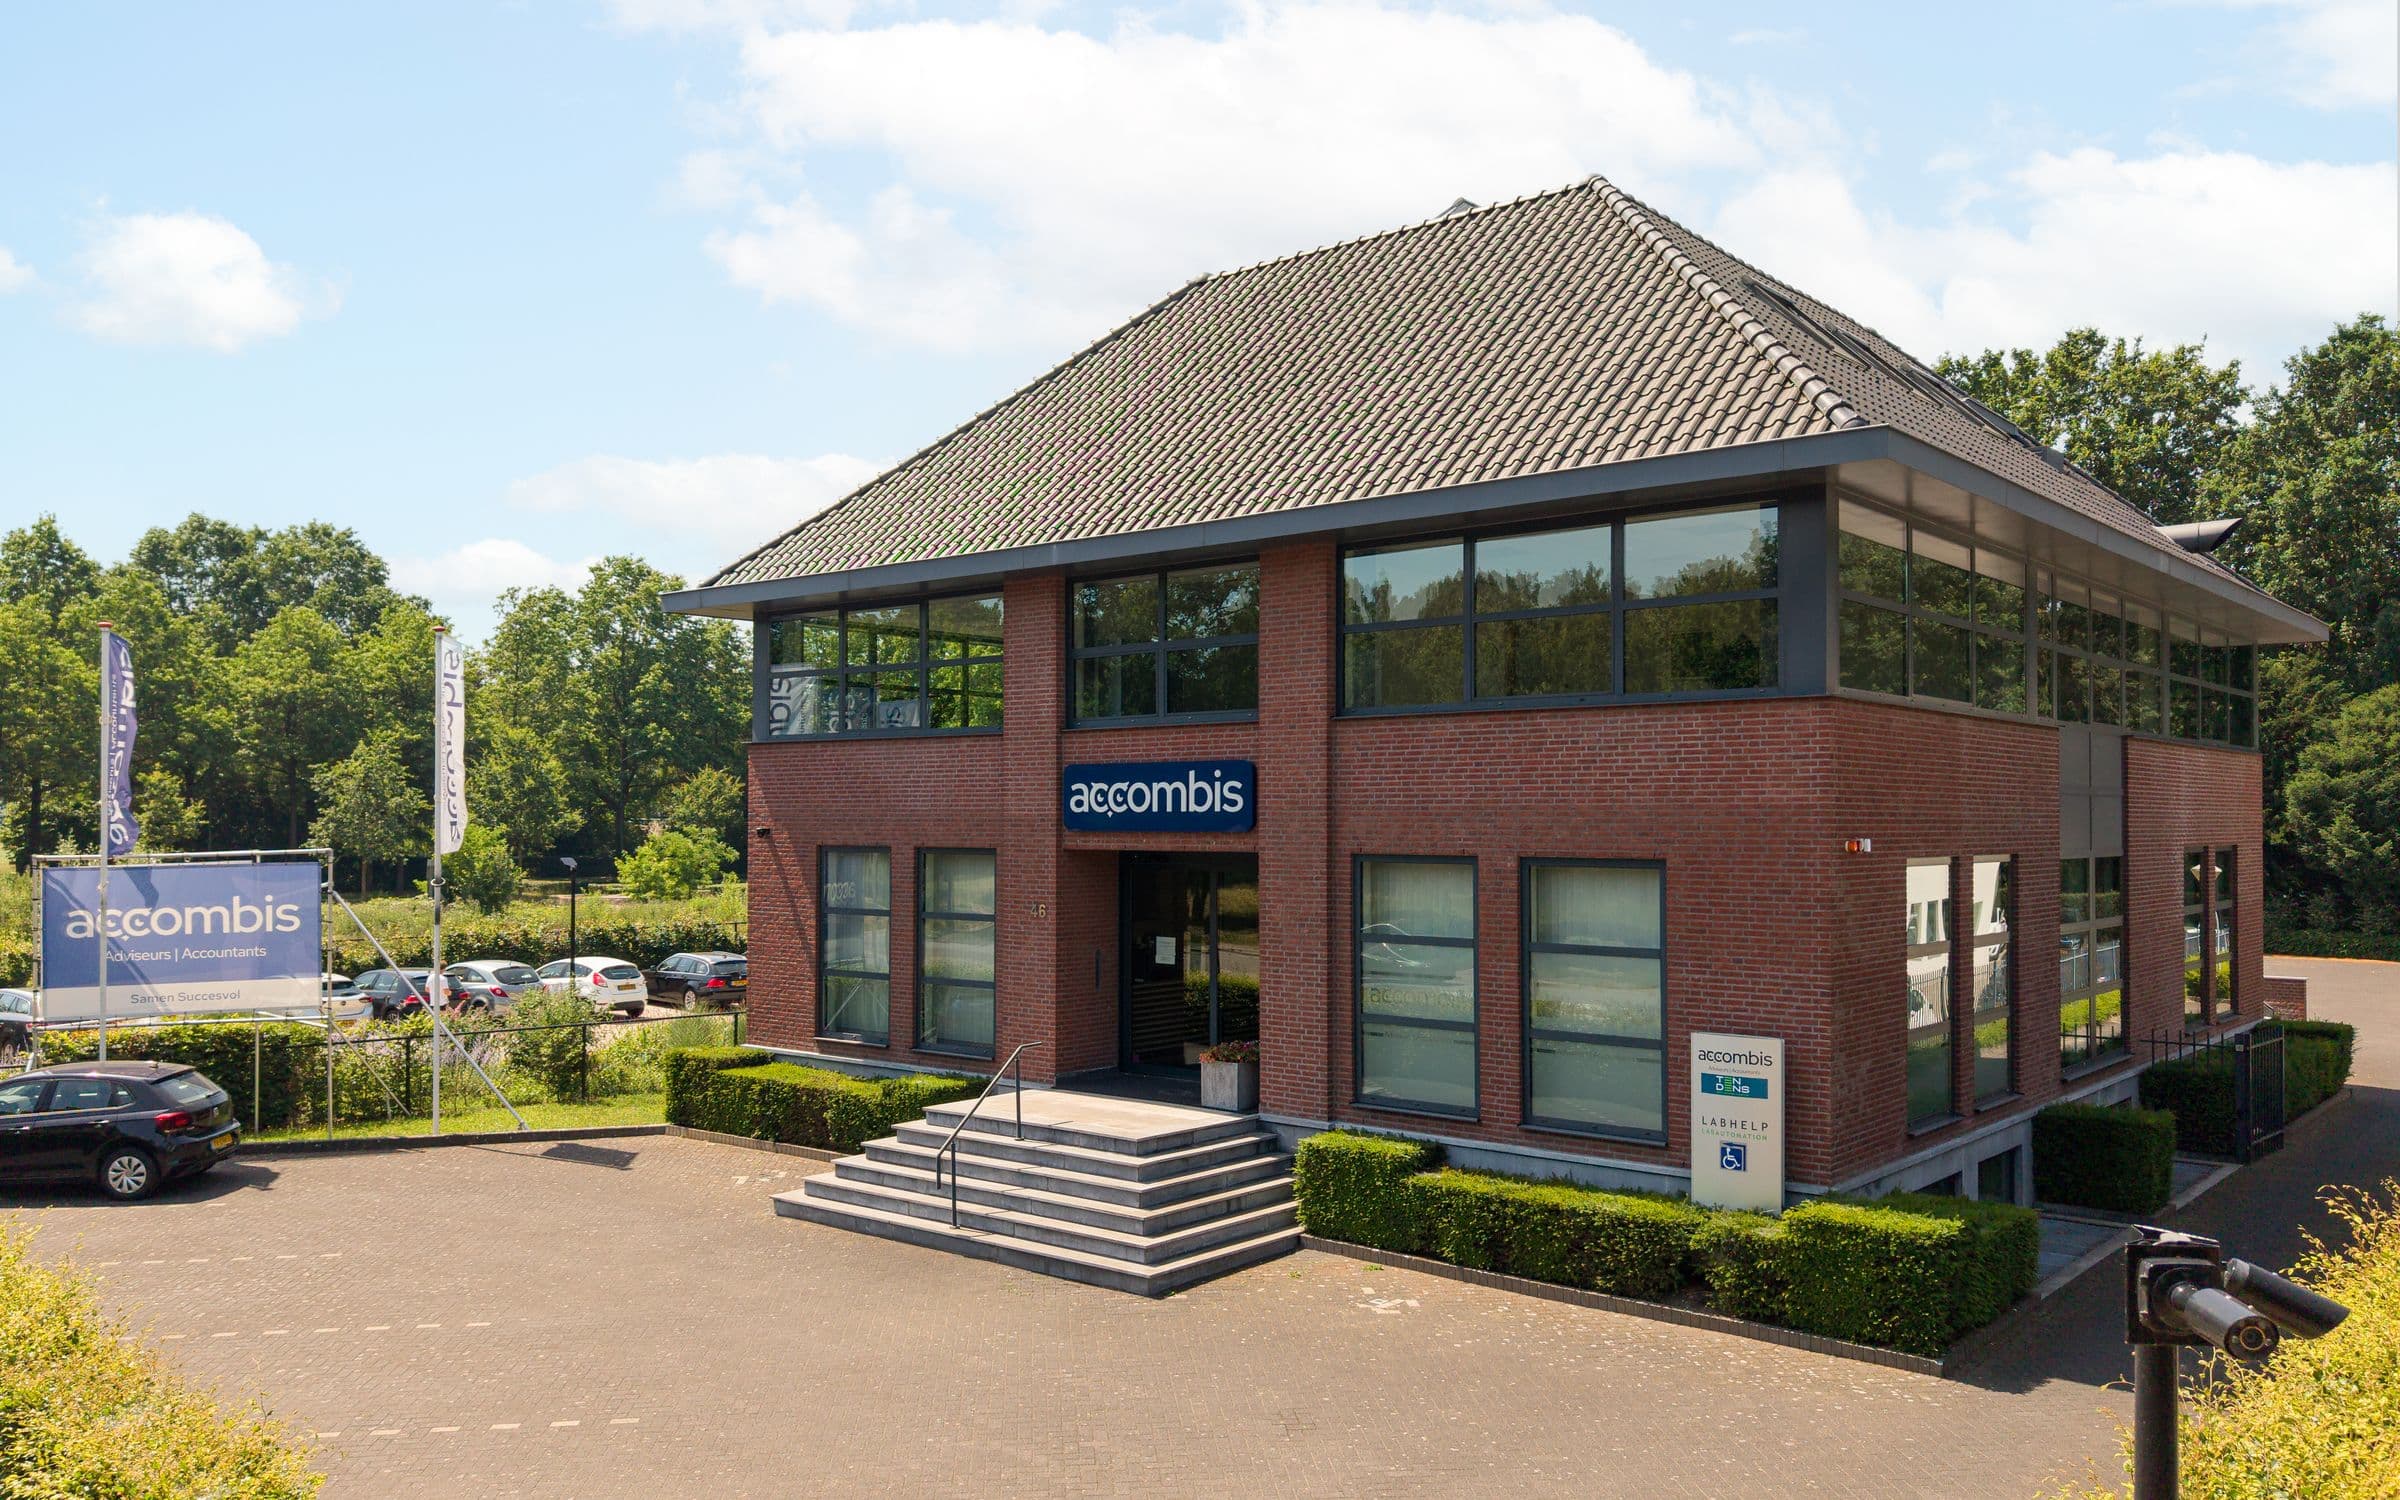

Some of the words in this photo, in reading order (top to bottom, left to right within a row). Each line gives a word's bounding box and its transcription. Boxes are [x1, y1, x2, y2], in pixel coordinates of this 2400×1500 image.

[1069, 769, 1244, 818] accombis
[65, 894, 301, 941] accombis
[1030, 903, 1046, 918] 46
[105, 949, 171, 963] Adviseurs
[182, 946, 267, 960] Accountants
[130, 993, 175, 1005] Samen
[178, 989, 241, 1003] Succesvol
[1698, 1050, 1773, 1067] accombis
[1702, 1116, 1768, 1131] LABHELP
